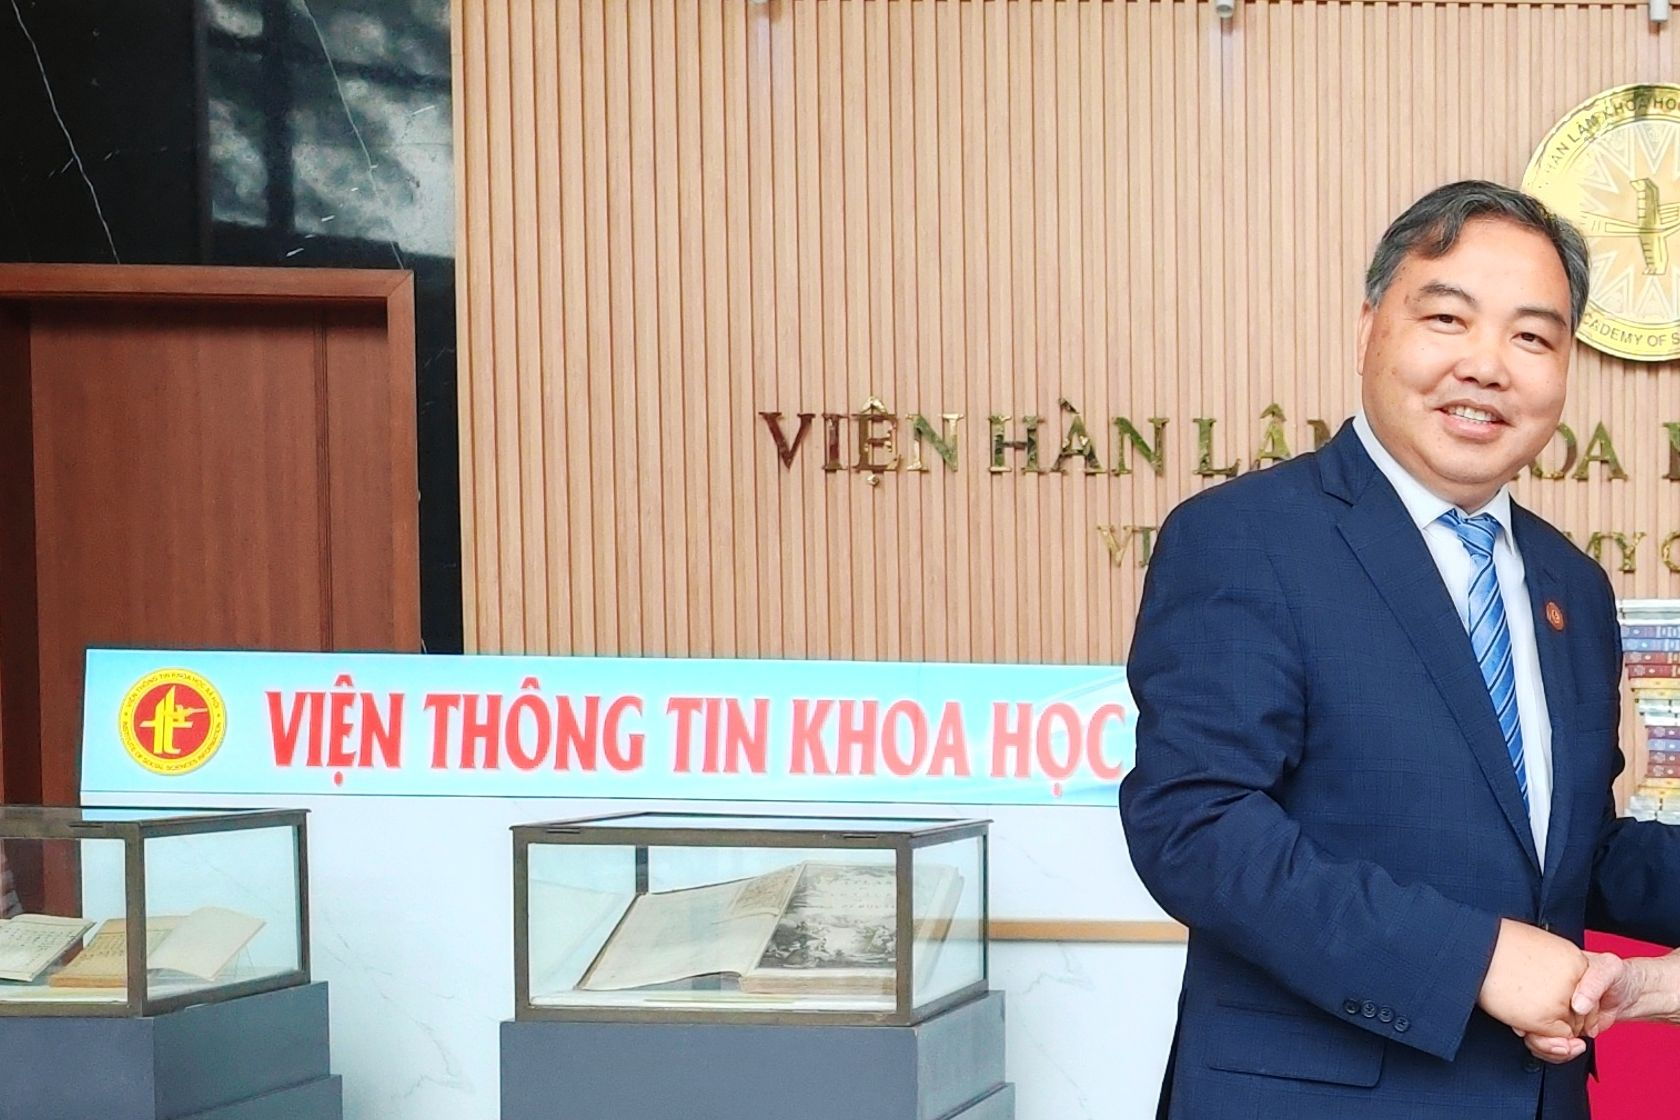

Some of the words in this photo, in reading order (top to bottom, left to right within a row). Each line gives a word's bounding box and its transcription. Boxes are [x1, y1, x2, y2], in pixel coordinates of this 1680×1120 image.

[1580, 312, 1643, 346] CADEMY
[1646, 334, 1667, 347] OF
[758, 396, 965, 487] VIỆN
[988, 398, 1170, 477] HÀN
[1193, 403, 1331, 476] LÂ
[265, 674, 405, 787] VIỆN
[423, 676, 645, 773] THÔNG
[666, 696, 770, 774] TIN
[789, 698, 972, 779] KHOA
[990, 702, 1127, 798] HỌC
